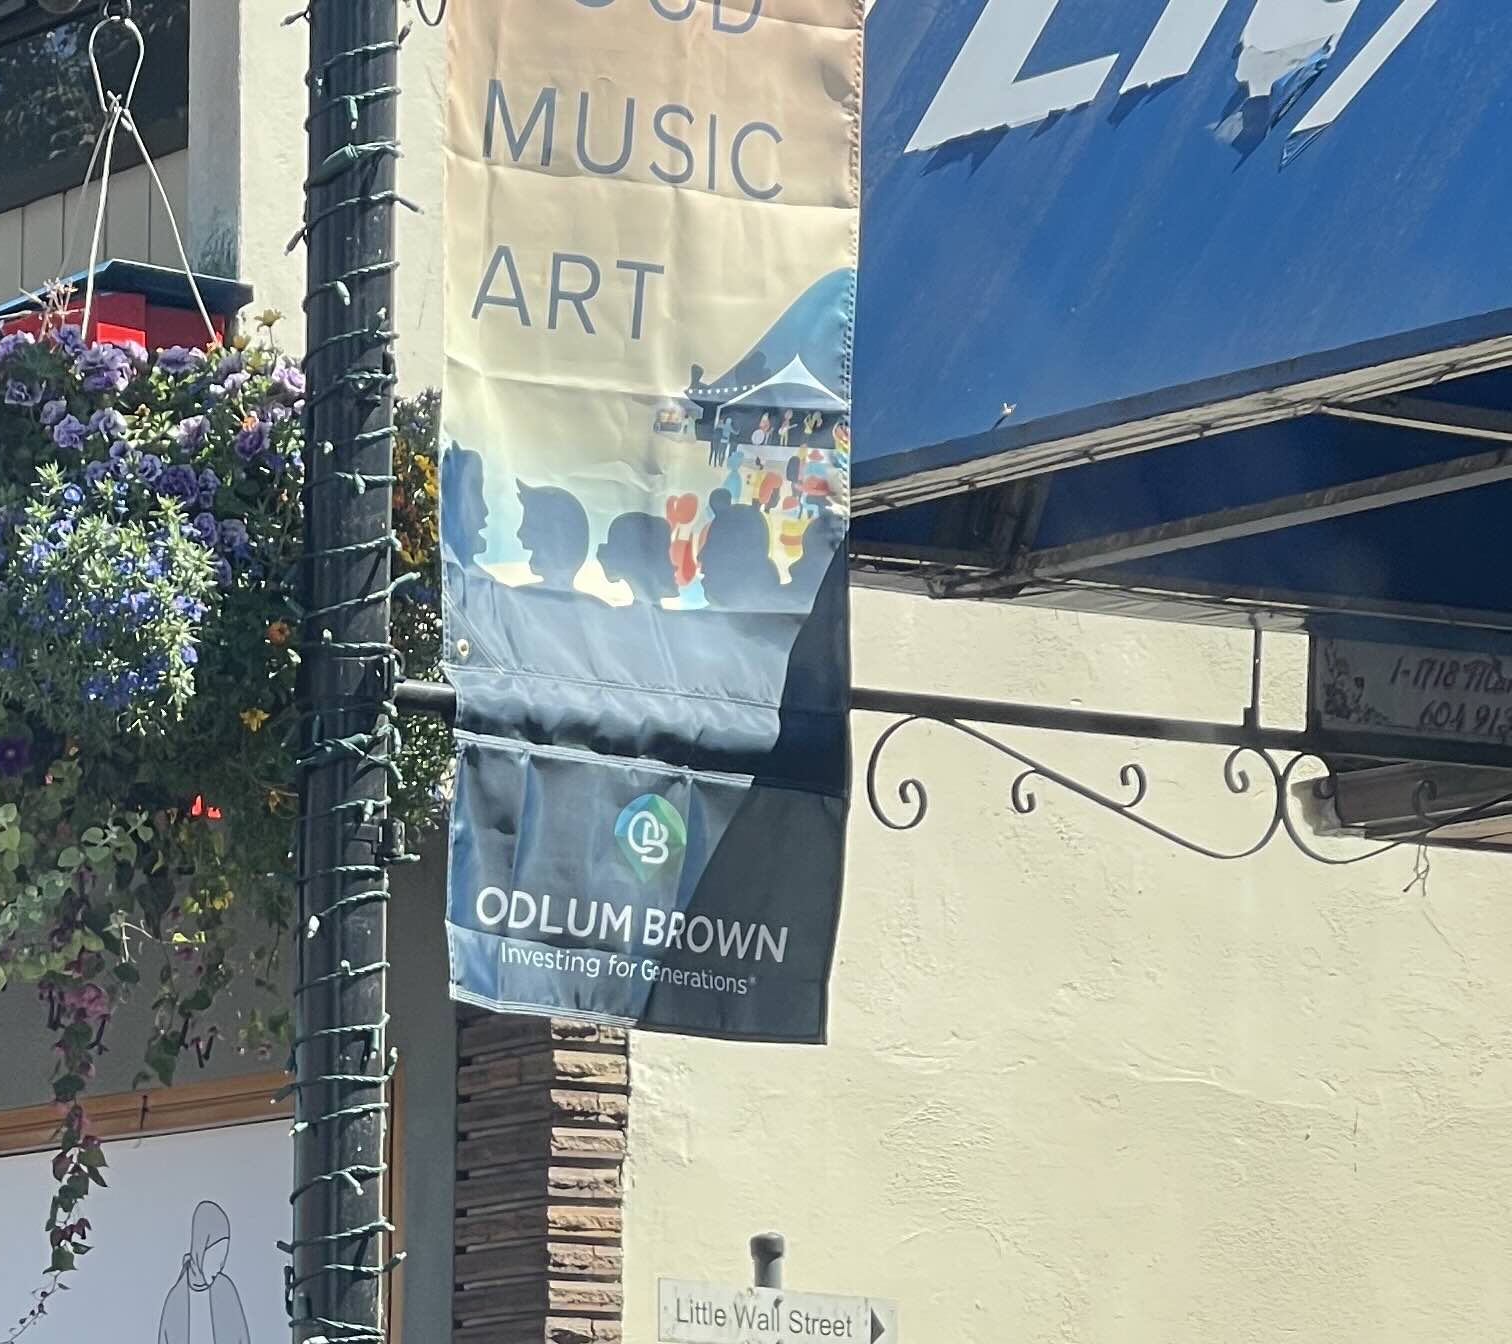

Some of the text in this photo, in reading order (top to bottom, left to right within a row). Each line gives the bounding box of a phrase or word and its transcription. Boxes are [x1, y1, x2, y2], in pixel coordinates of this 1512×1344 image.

[481, 79, 784, 201] MUSIC
[471, 245, 665, 340] ART
[475, 885, 789, 963] ODLUM BROWN
[500, 941, 601, 978] Investing
[608, 951, 638, 979] for
[675, 1297, 854, 1338] Little Wall Street
